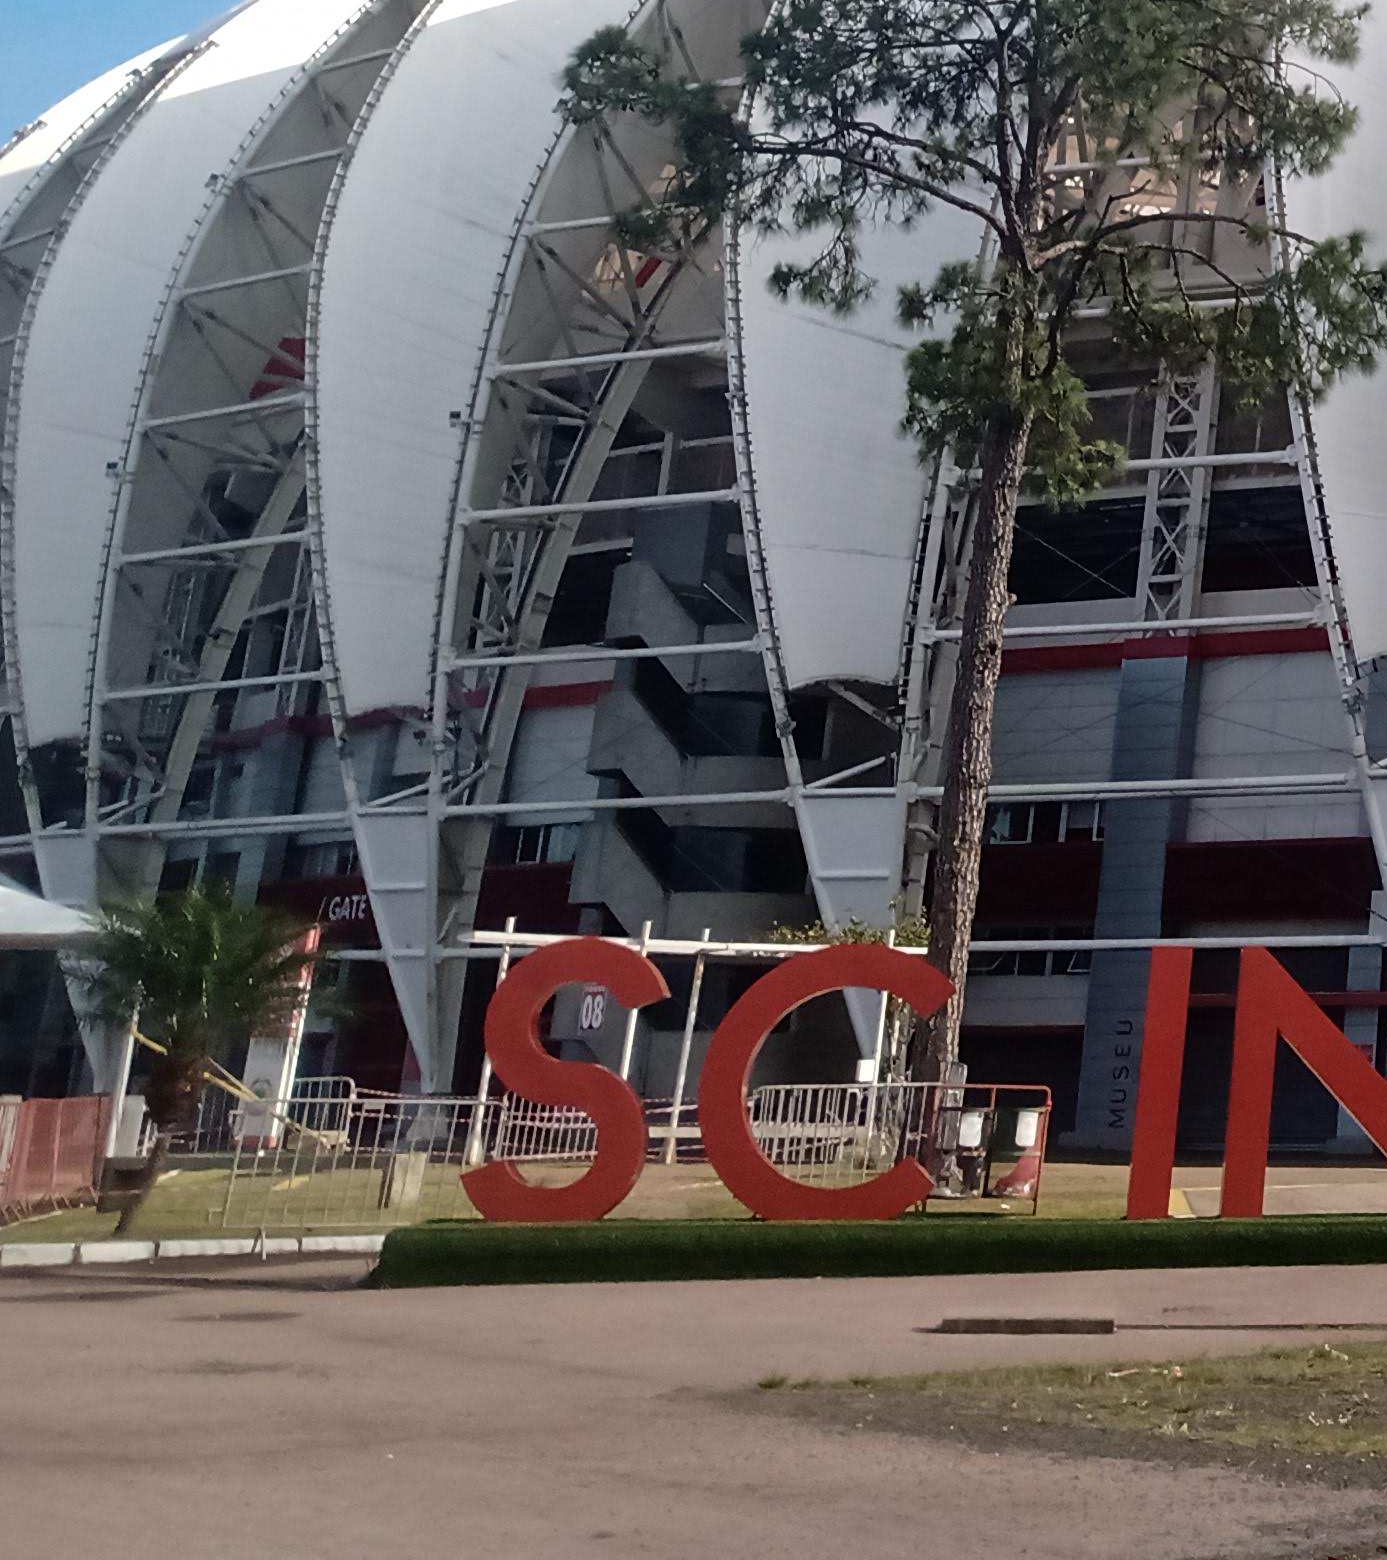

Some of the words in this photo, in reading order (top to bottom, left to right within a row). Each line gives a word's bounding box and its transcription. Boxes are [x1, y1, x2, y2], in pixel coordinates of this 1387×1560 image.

[328, 894, 367, 920] GATE
[582, 994, 604, 1029] 08
[461, 936, 956, 1221] SC
[1108, 1020, 1133, 1129] MUSEU
